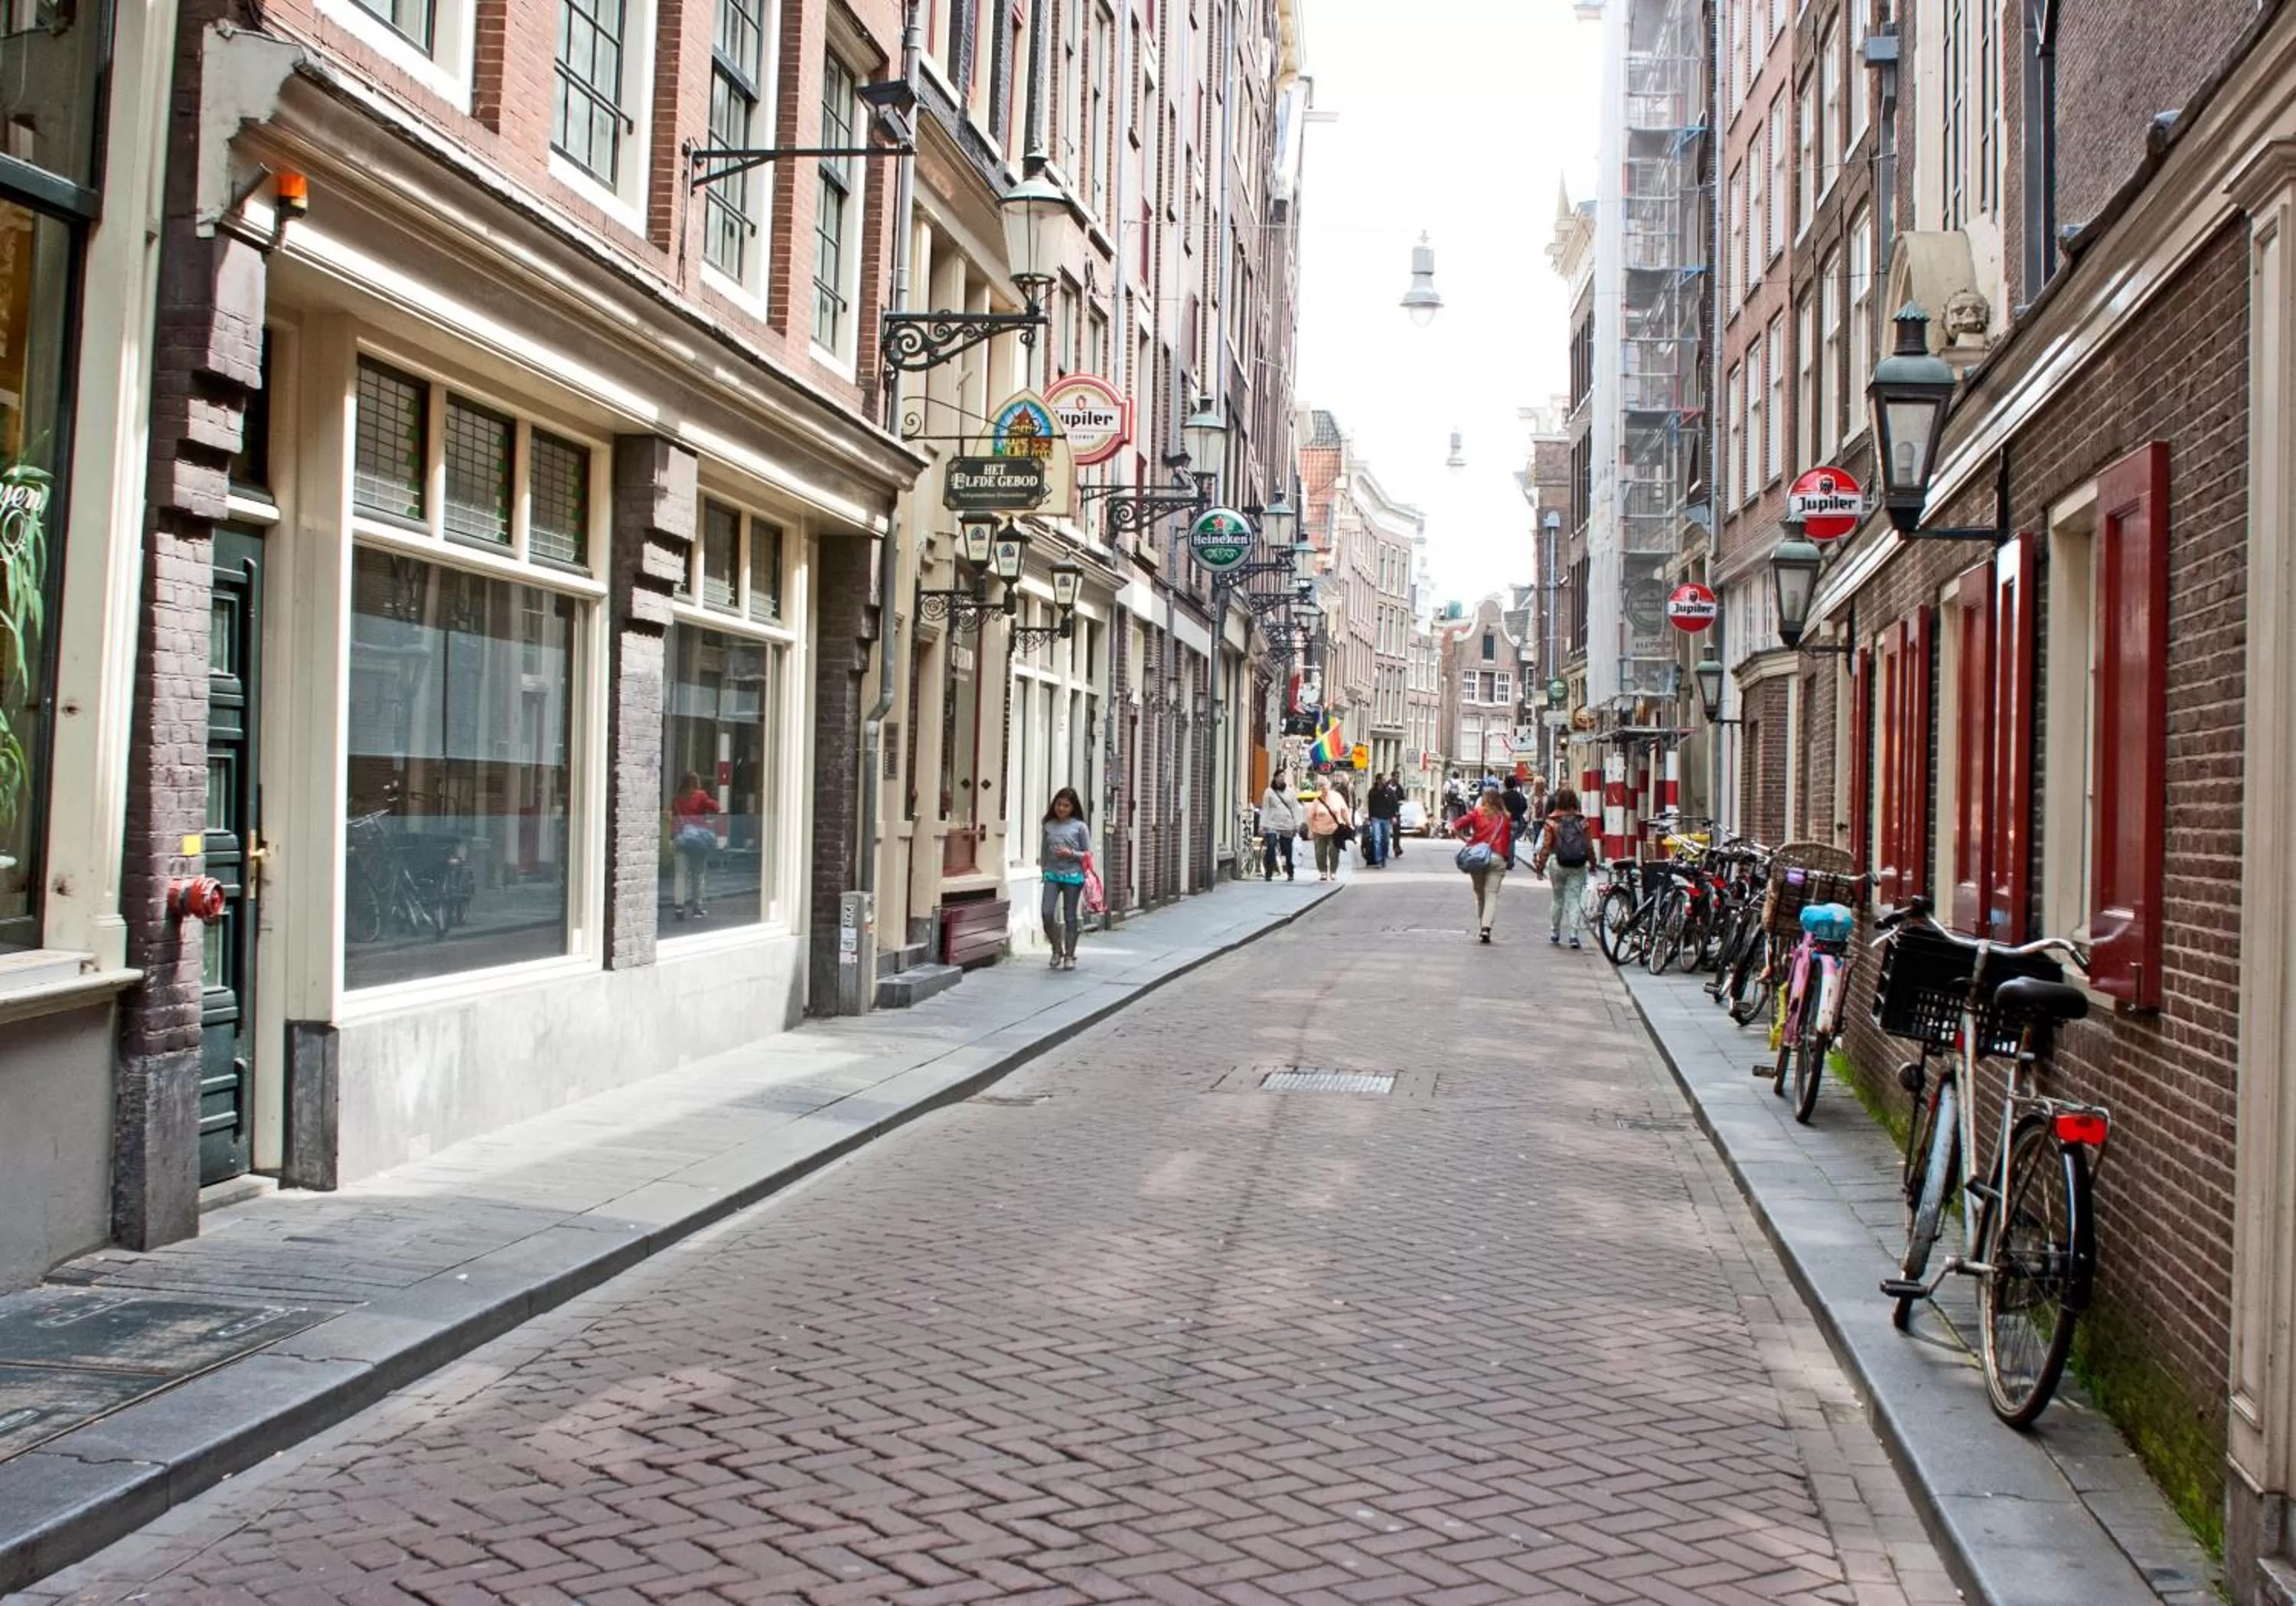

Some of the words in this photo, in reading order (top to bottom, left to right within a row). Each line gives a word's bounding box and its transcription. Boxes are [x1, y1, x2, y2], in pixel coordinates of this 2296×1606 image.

[1055, 410, 1113, 427] upiler
[983, 464, 1006, 475] HET
[951, 473, 995, 489] ELFDE
[997, 475, 1039, 488] GEBOD
[1799, 495, 1857, 513] Jupiler
[1193, 534, 1248, 545] Heineken
[1675, 602, 1714, 614] Jupiler
